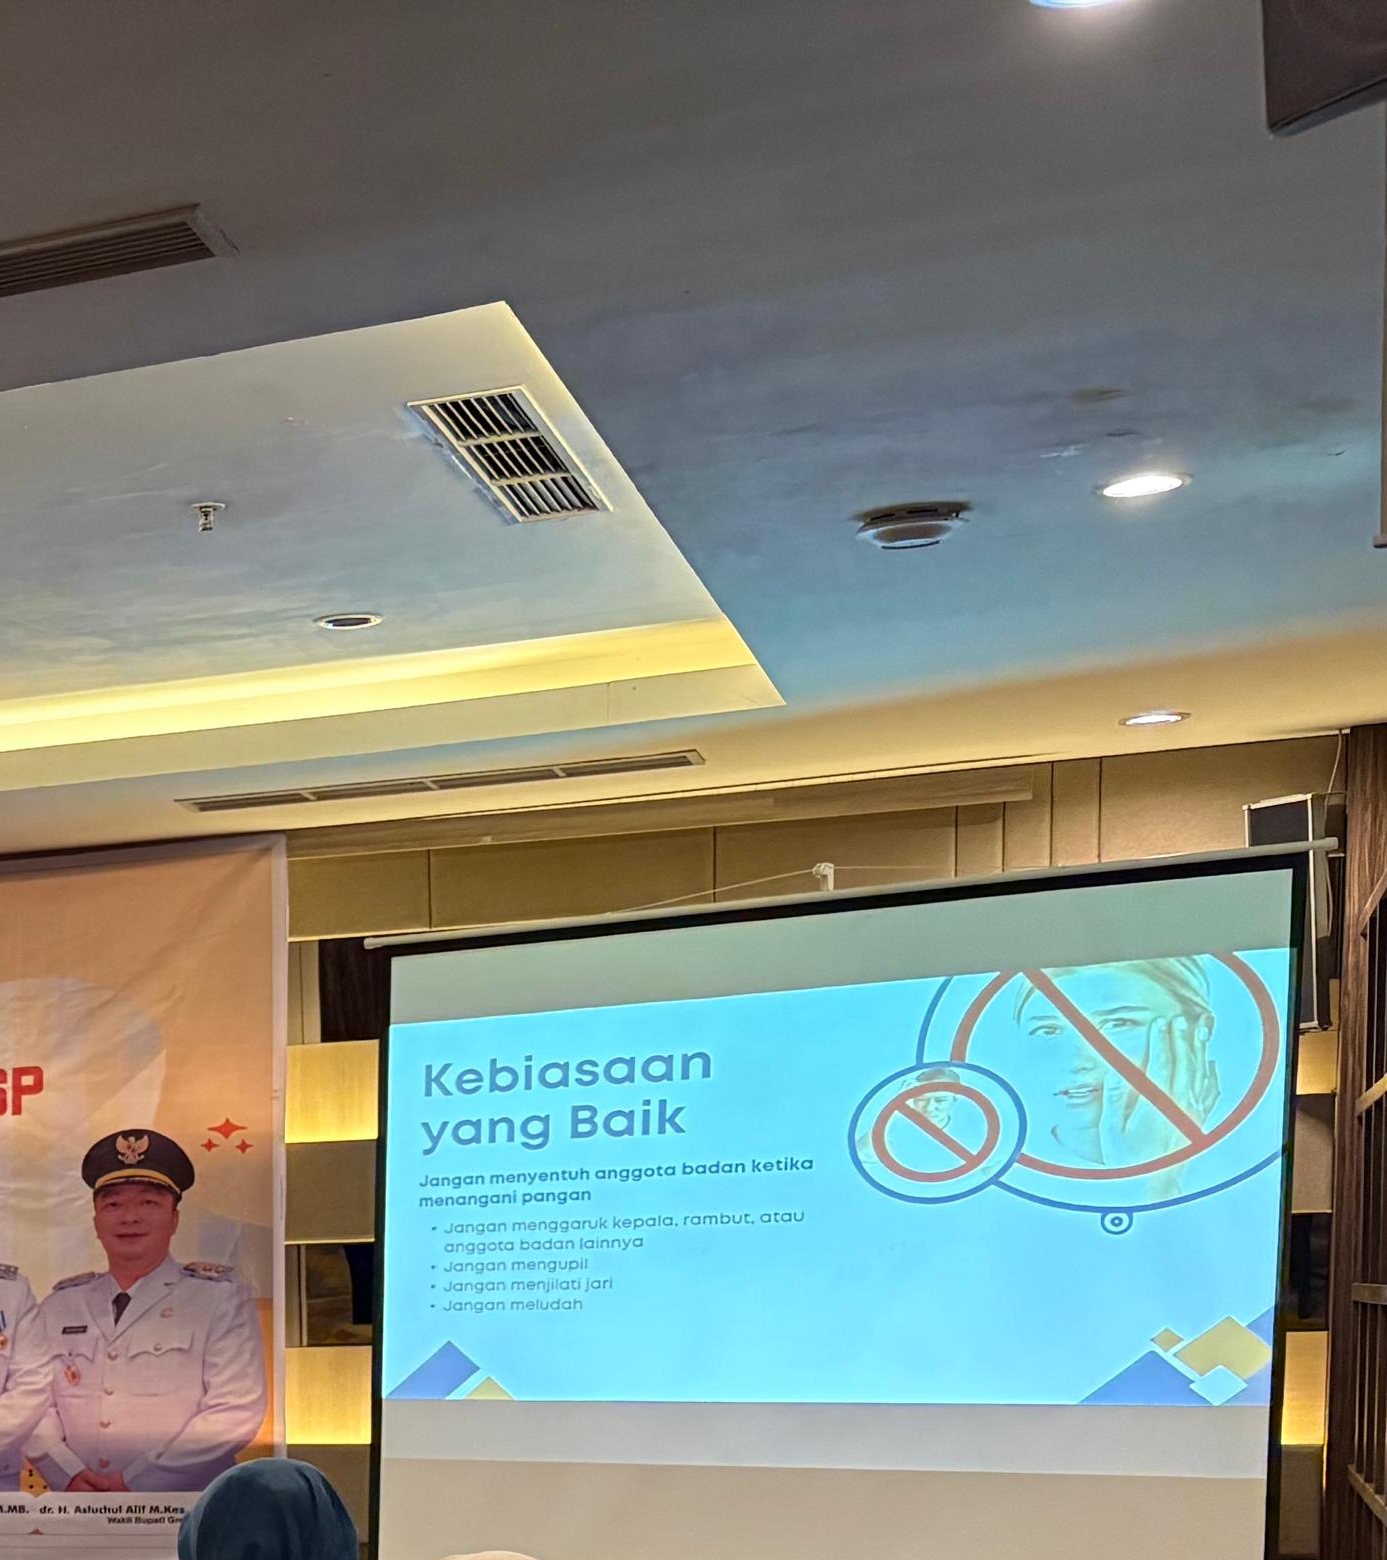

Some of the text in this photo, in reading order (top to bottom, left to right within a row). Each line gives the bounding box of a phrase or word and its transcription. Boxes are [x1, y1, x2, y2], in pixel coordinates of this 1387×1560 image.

[424, 1051, 711, 1097] Kebiasaan
[421, 1099, 686, 1155] yang Baik
[419, 1156, 814, 1189] Jangan menyentuh anggota badan ketika
[419, 1190, 592, 1208] menangani pangan
[443, 1211, 805, 1236] Jangan menggaruk kepala, rambut, atau
[443, 1236, 644, 1255] anggota badan lainnya
[443, 1257, 589, 1275] Jangan mengupil
[443, 1276, 613, 1294] Jangan menjilati jari
[442, 1297, 584, 1314] Jangan meludah
